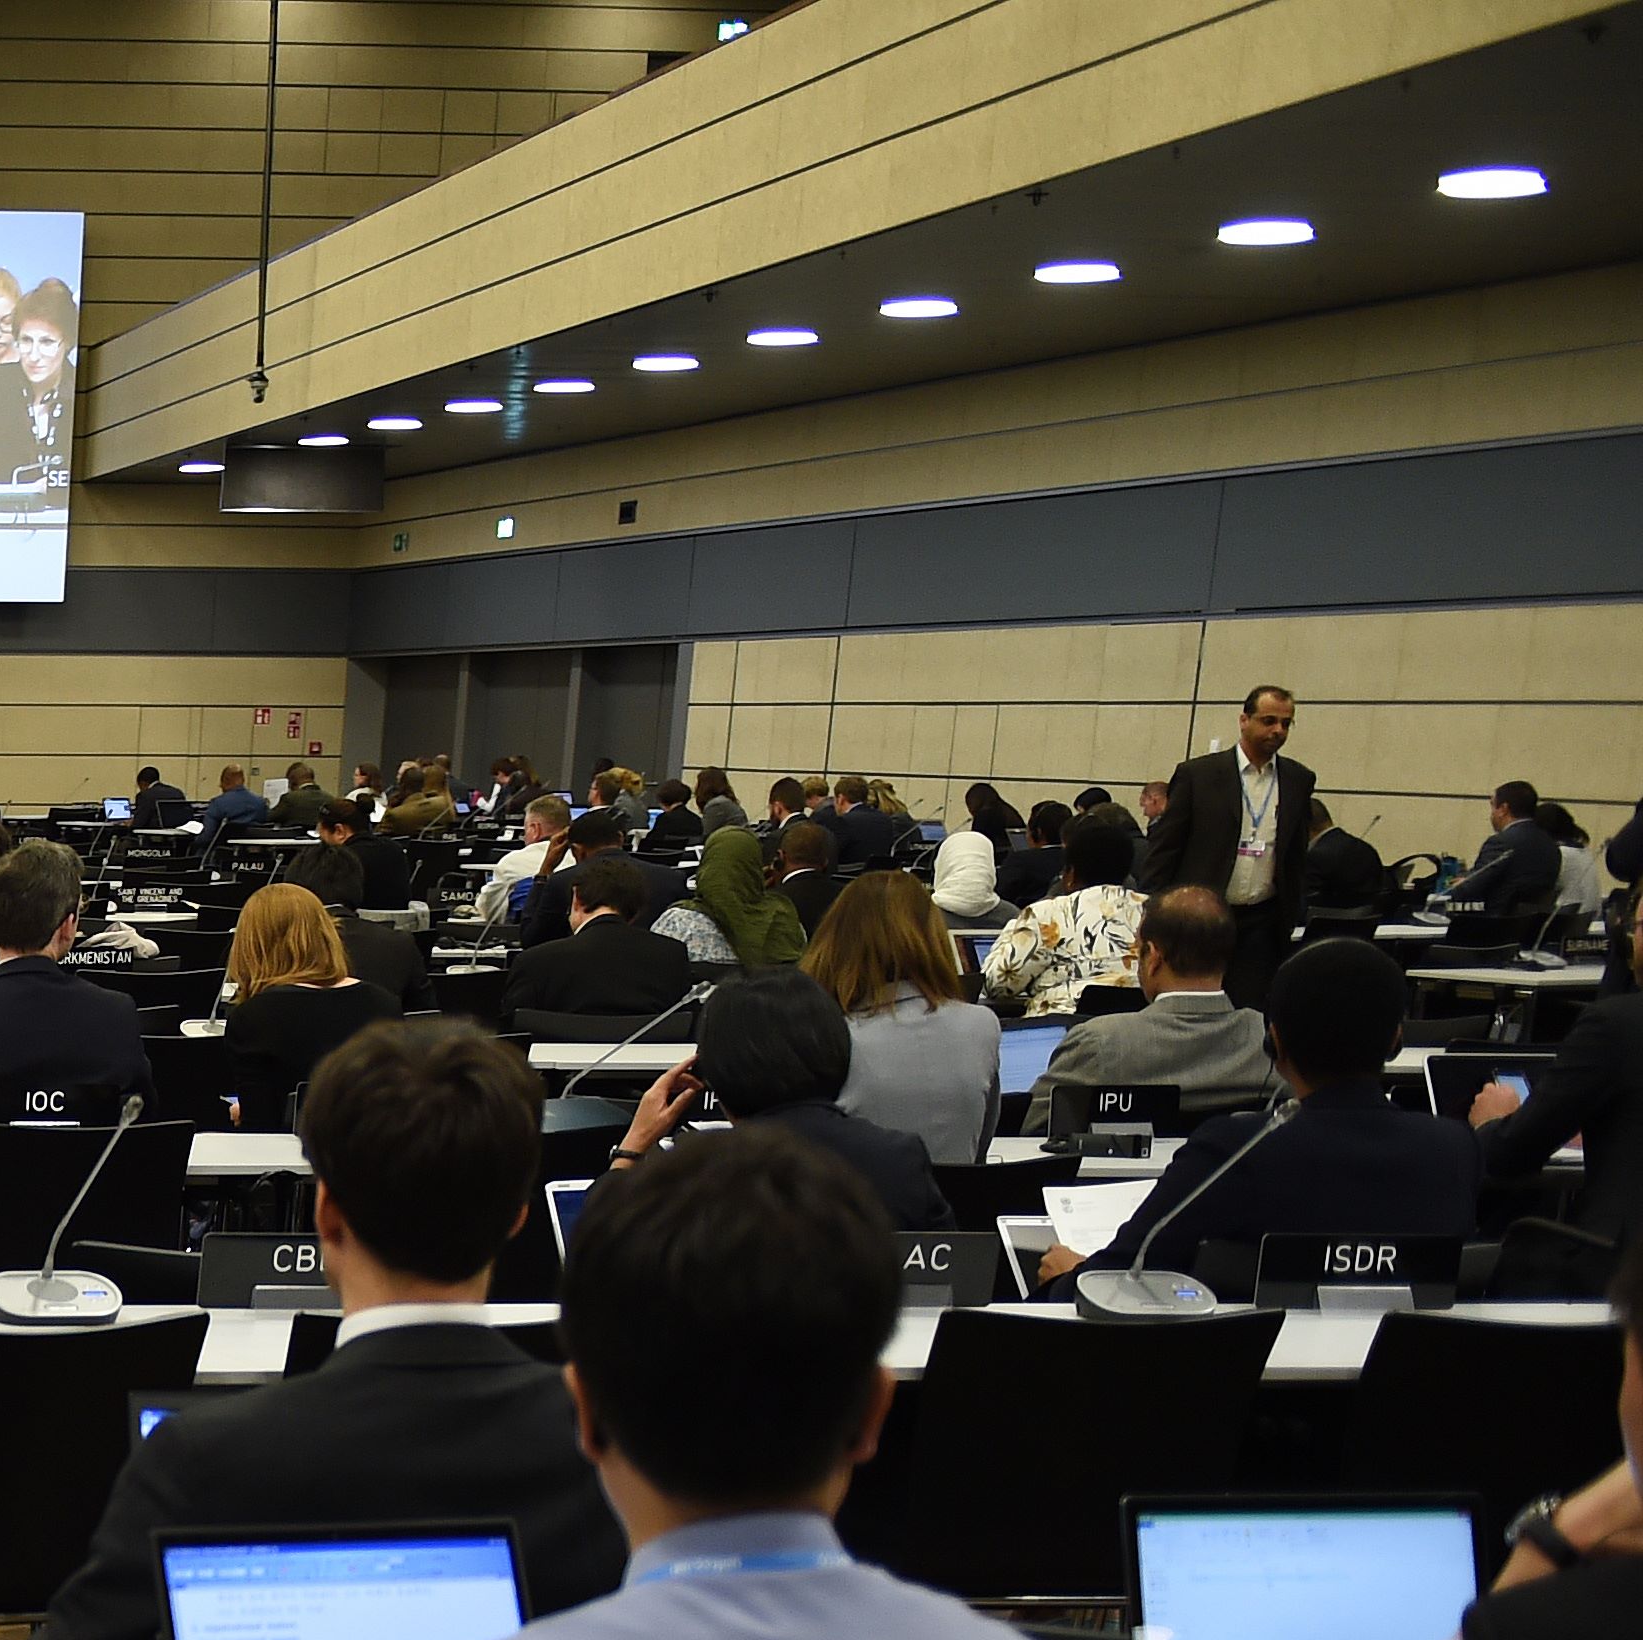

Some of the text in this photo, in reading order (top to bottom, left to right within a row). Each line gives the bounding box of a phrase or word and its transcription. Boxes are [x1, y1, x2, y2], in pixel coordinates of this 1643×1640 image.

[232, 862, 265, 871] PALAU
[25, 1090, 65, 1112] IOC
[1099, 1092, 1133, 1113] IPU
[903, 1243, 952, 1271] AC
[1324, 1244, 1397, 1273] ISDR
